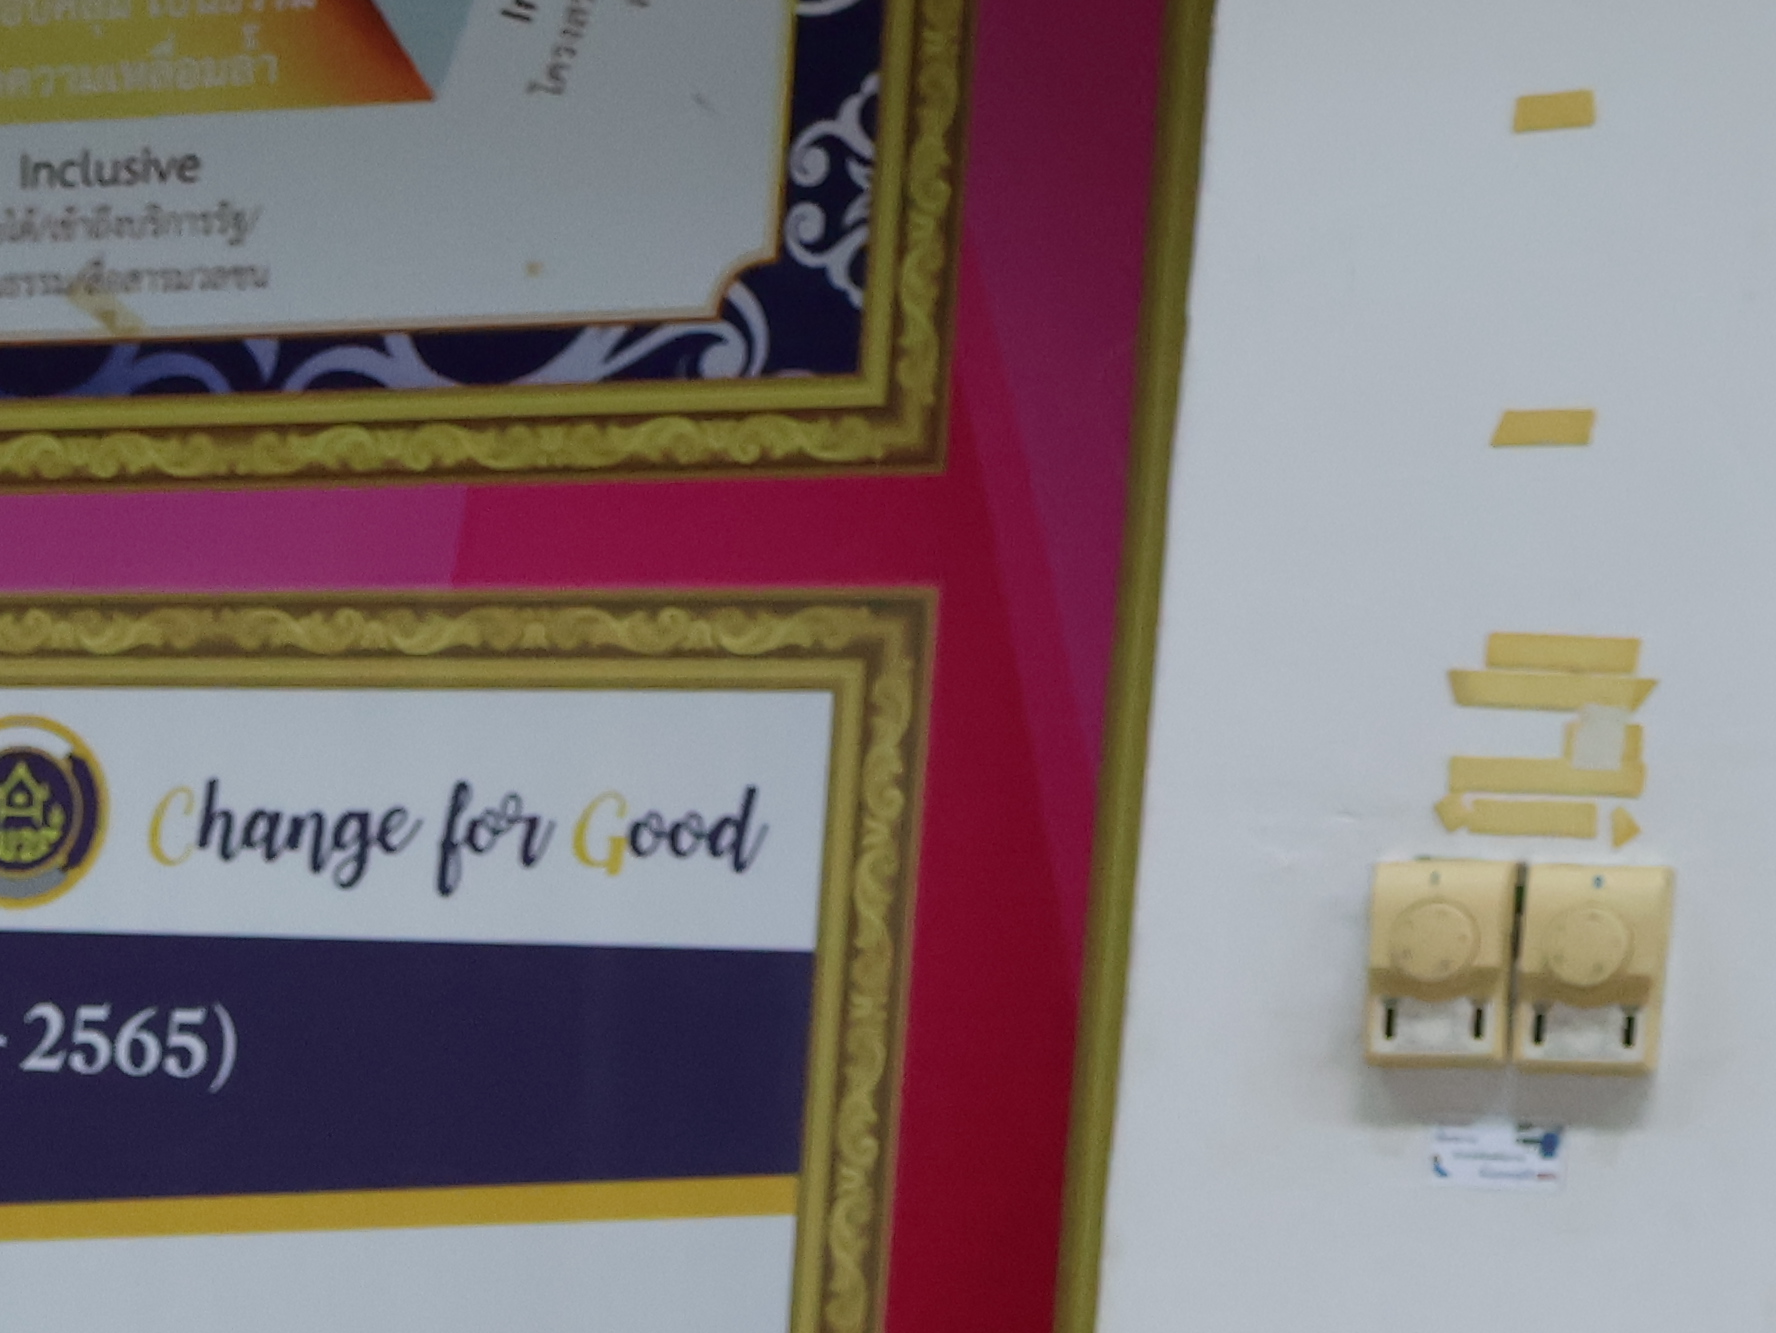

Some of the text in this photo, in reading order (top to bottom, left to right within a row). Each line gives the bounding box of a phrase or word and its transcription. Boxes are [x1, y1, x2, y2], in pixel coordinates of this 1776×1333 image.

[19, 146, 201, 190] Inclusive
[147, 777, 769, 897] Change for Good
